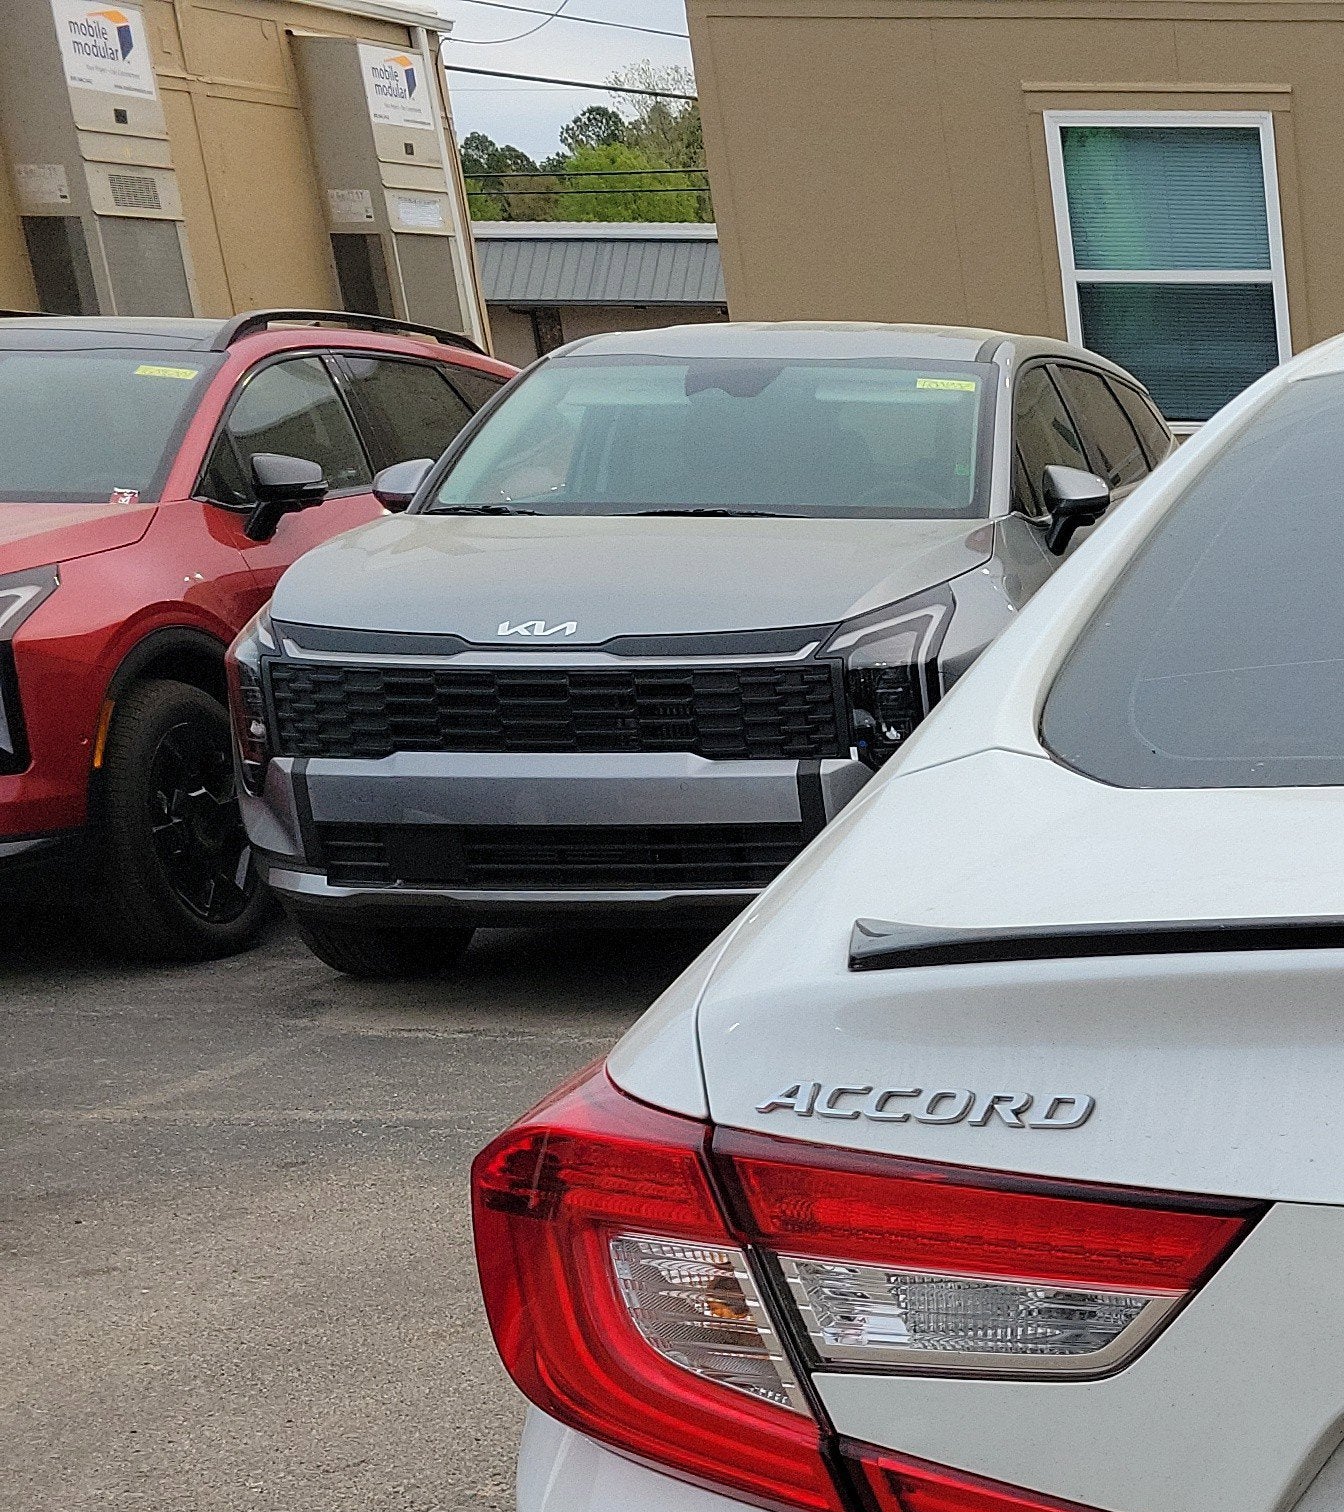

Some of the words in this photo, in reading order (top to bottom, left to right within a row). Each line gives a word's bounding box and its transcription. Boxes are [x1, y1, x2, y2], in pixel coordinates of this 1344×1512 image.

[68, 18, 108, 40] mobile
[72, 39, 119, 60] modular
[371, 64, 399, 82] mobile
[374, 82, 407, 99] modular
[497, 620, 577, 636] KIA
[755, 1081, 1096, 1129] ACCORD
